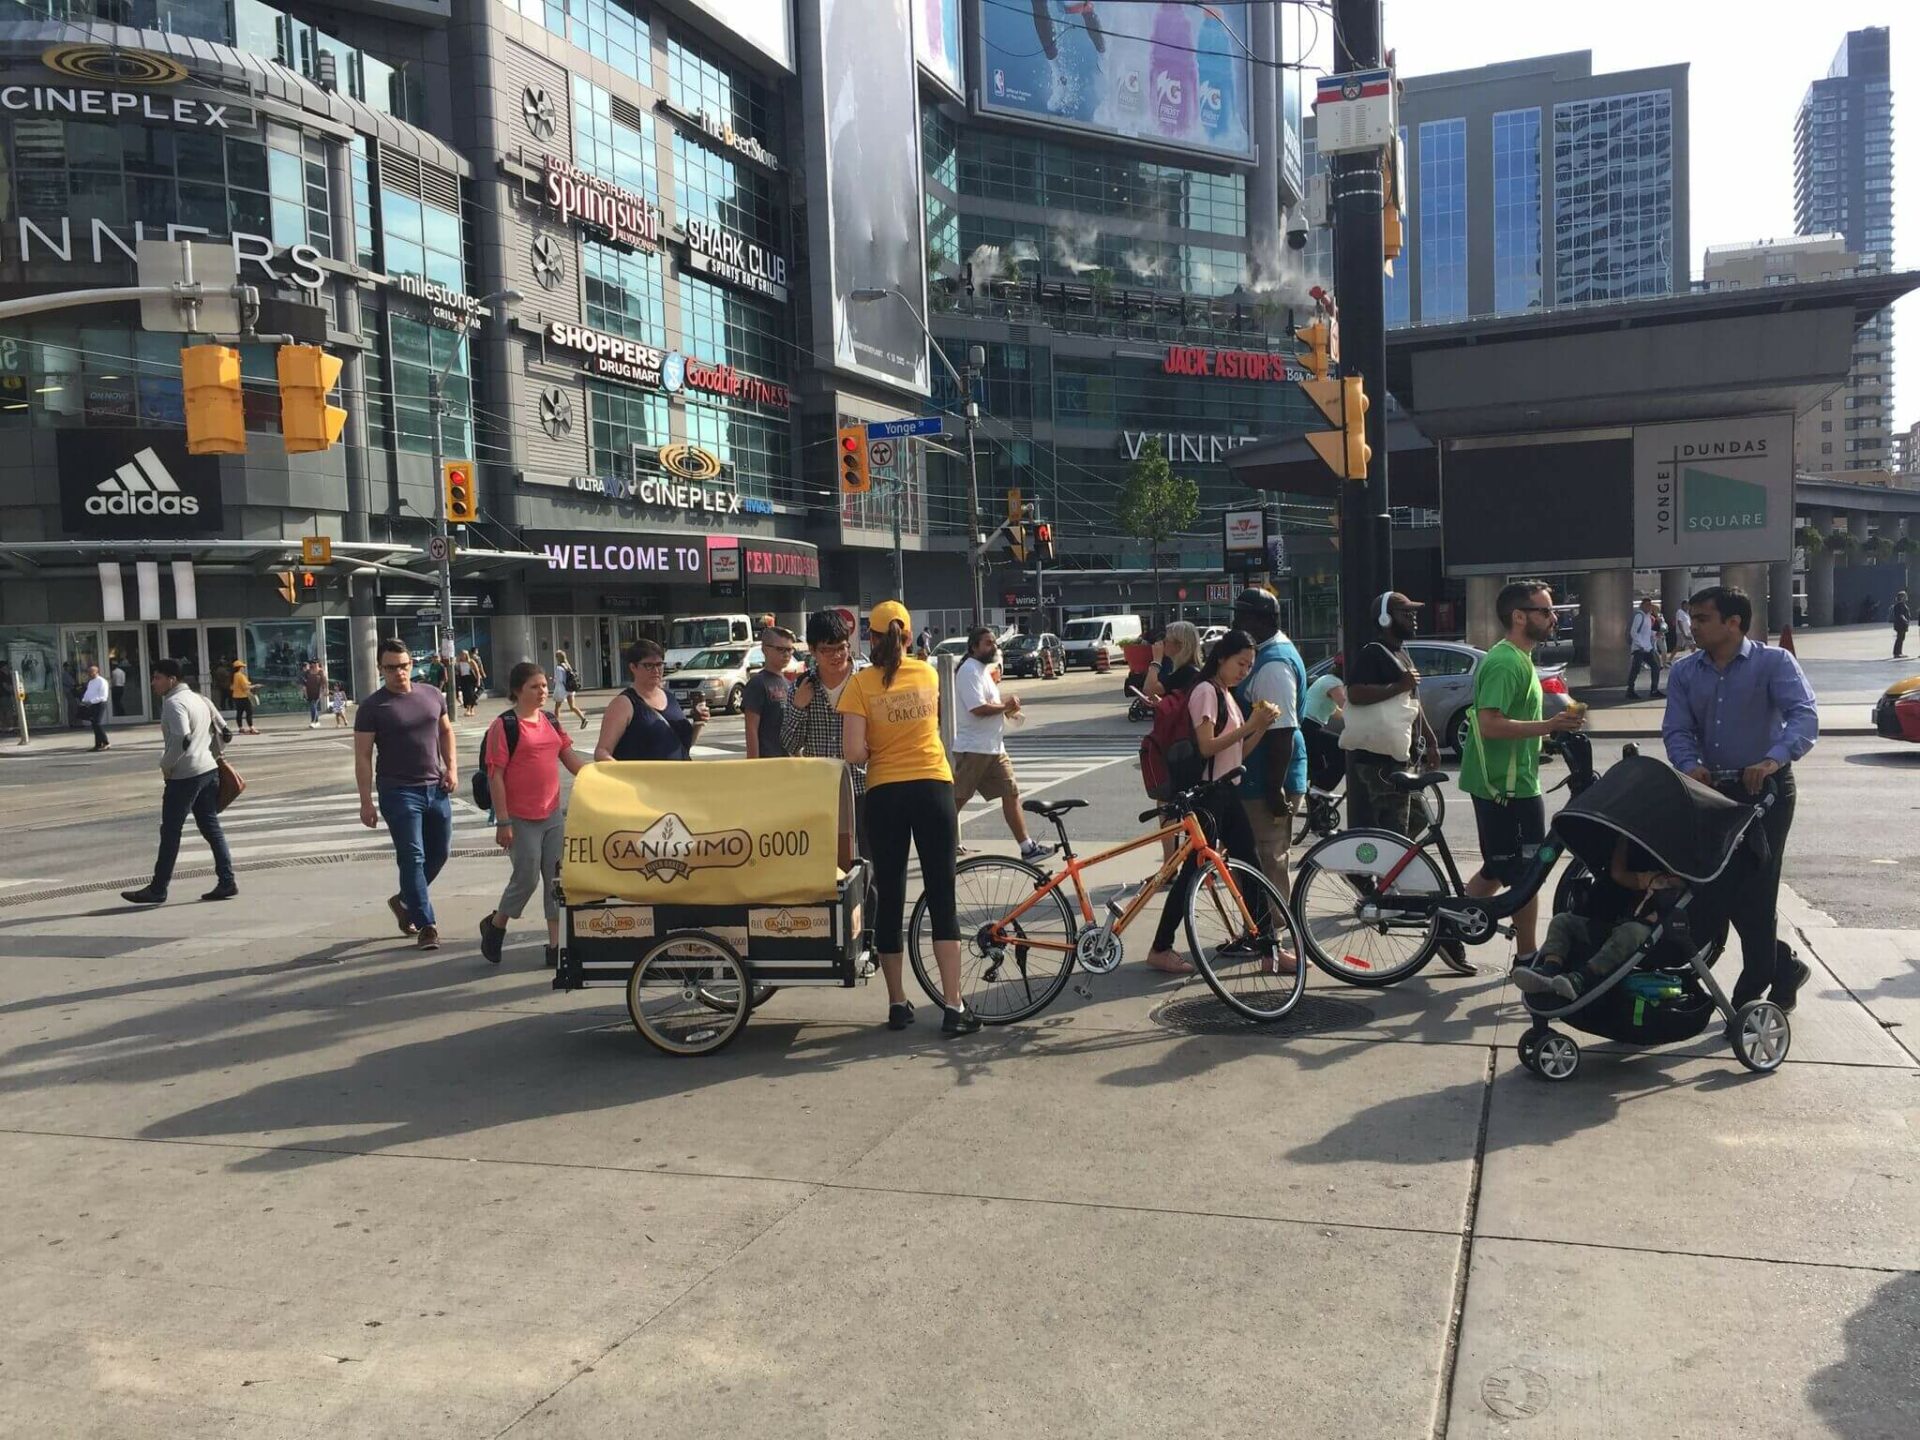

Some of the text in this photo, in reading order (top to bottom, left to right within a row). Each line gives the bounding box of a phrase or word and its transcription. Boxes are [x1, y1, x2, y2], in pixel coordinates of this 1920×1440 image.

[1, 86, 229, 129] CINEPLEX
[688, 219, 787, 286] SHARK CLUB
[711, 258, 740, 283] SPORTS
[400, 274, 481, 315] milestones
[551, 322, 661, 369] SHOPPERS
[599, 358, 661, 384] DRUG MART
[1163, 344, 1208, 376] JACK
[1214, 351, 1286, 382] ASTOR'S
[686, 357, 790, 408] GoodLife FITNESS
[885, 422, 917, 435] Yonge
[1684, 440, 1767, 456] DUNDAS
[85, 492, 199, 515] adidas
[640, 481, 740, 514] CINEPLEX
[745, 500, 774, 514] IMAX
[1657, 472, 1670, 533] YONGE
[1689, 513, 1763, 530] SQUARE
[543, 544, 699, 571] WELCOME TO
[1015, 594, 1037, 605] wine
[563, 835, 598, 864] FEEL
[759, 831, 810, 858] GOOD
